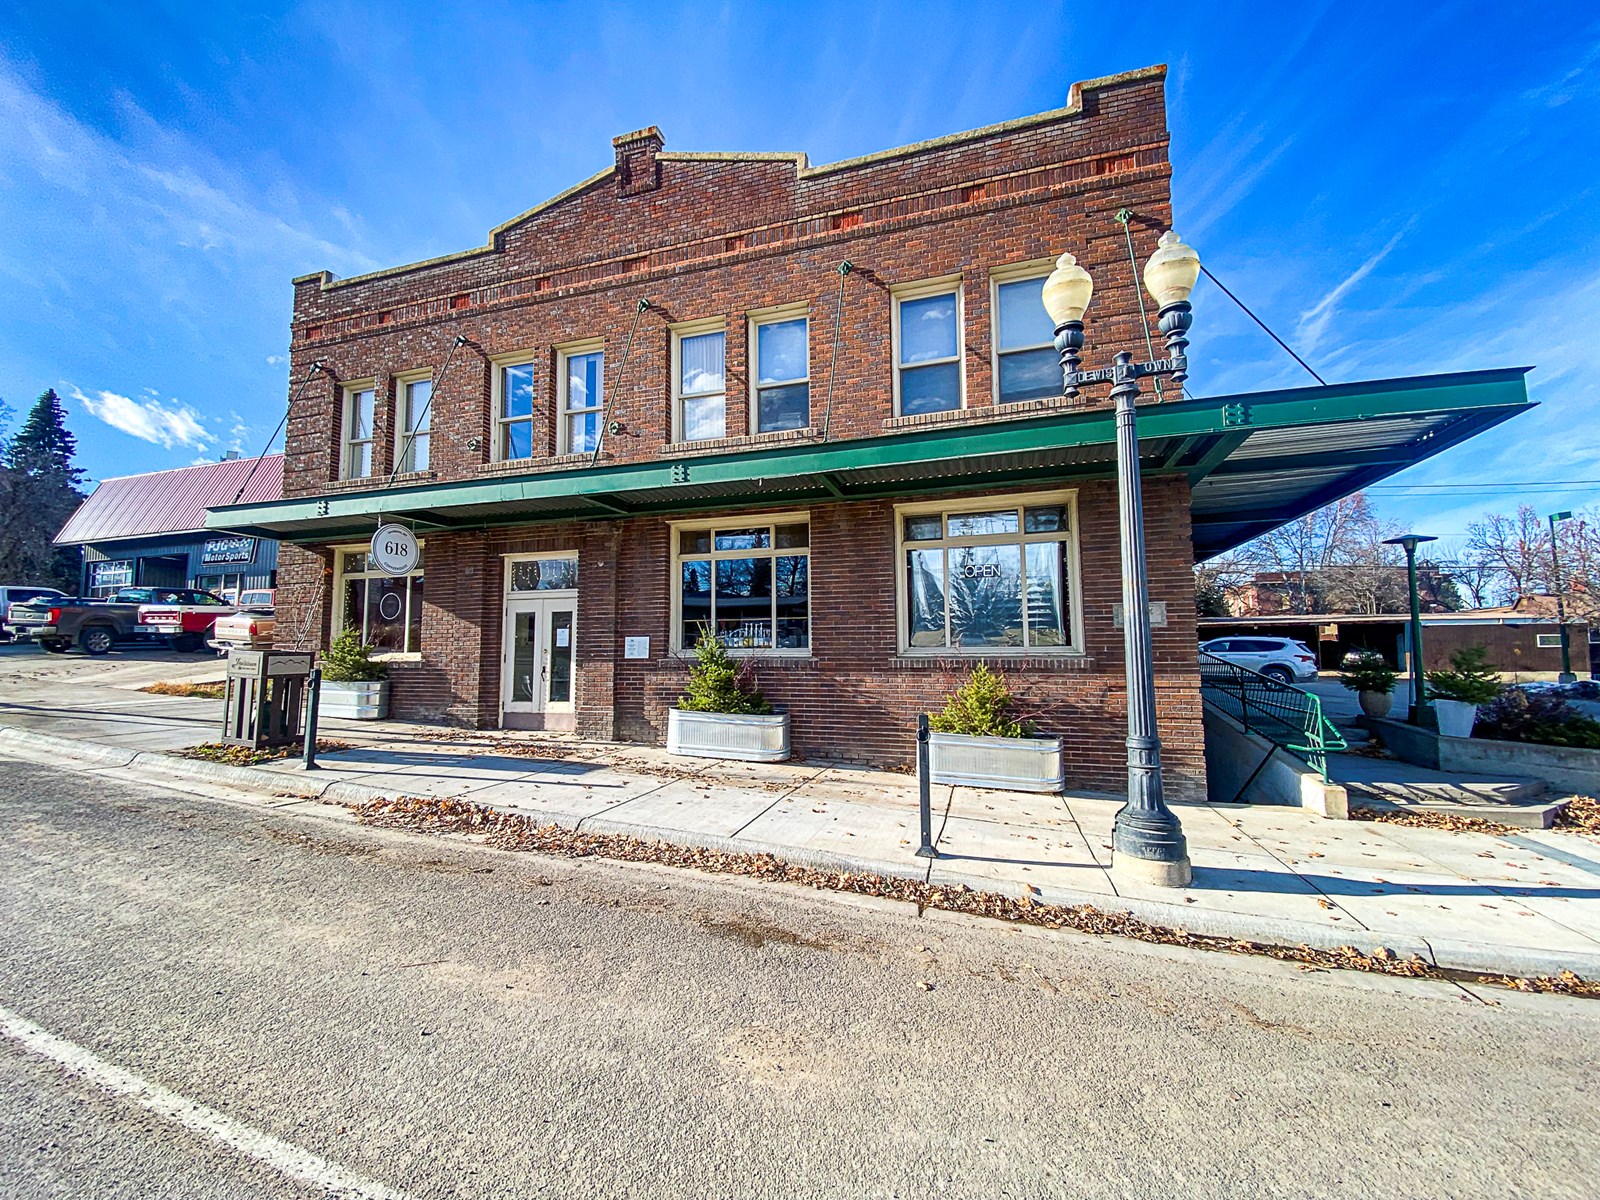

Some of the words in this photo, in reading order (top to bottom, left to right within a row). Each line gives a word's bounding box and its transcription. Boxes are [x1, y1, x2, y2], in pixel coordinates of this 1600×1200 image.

[207, 540, 229, 552] PJG
[385, 541, 408, 557] 618
[204, 552, 250, 562] MotorSports
[964, 564, 1001, 578] OPEN
